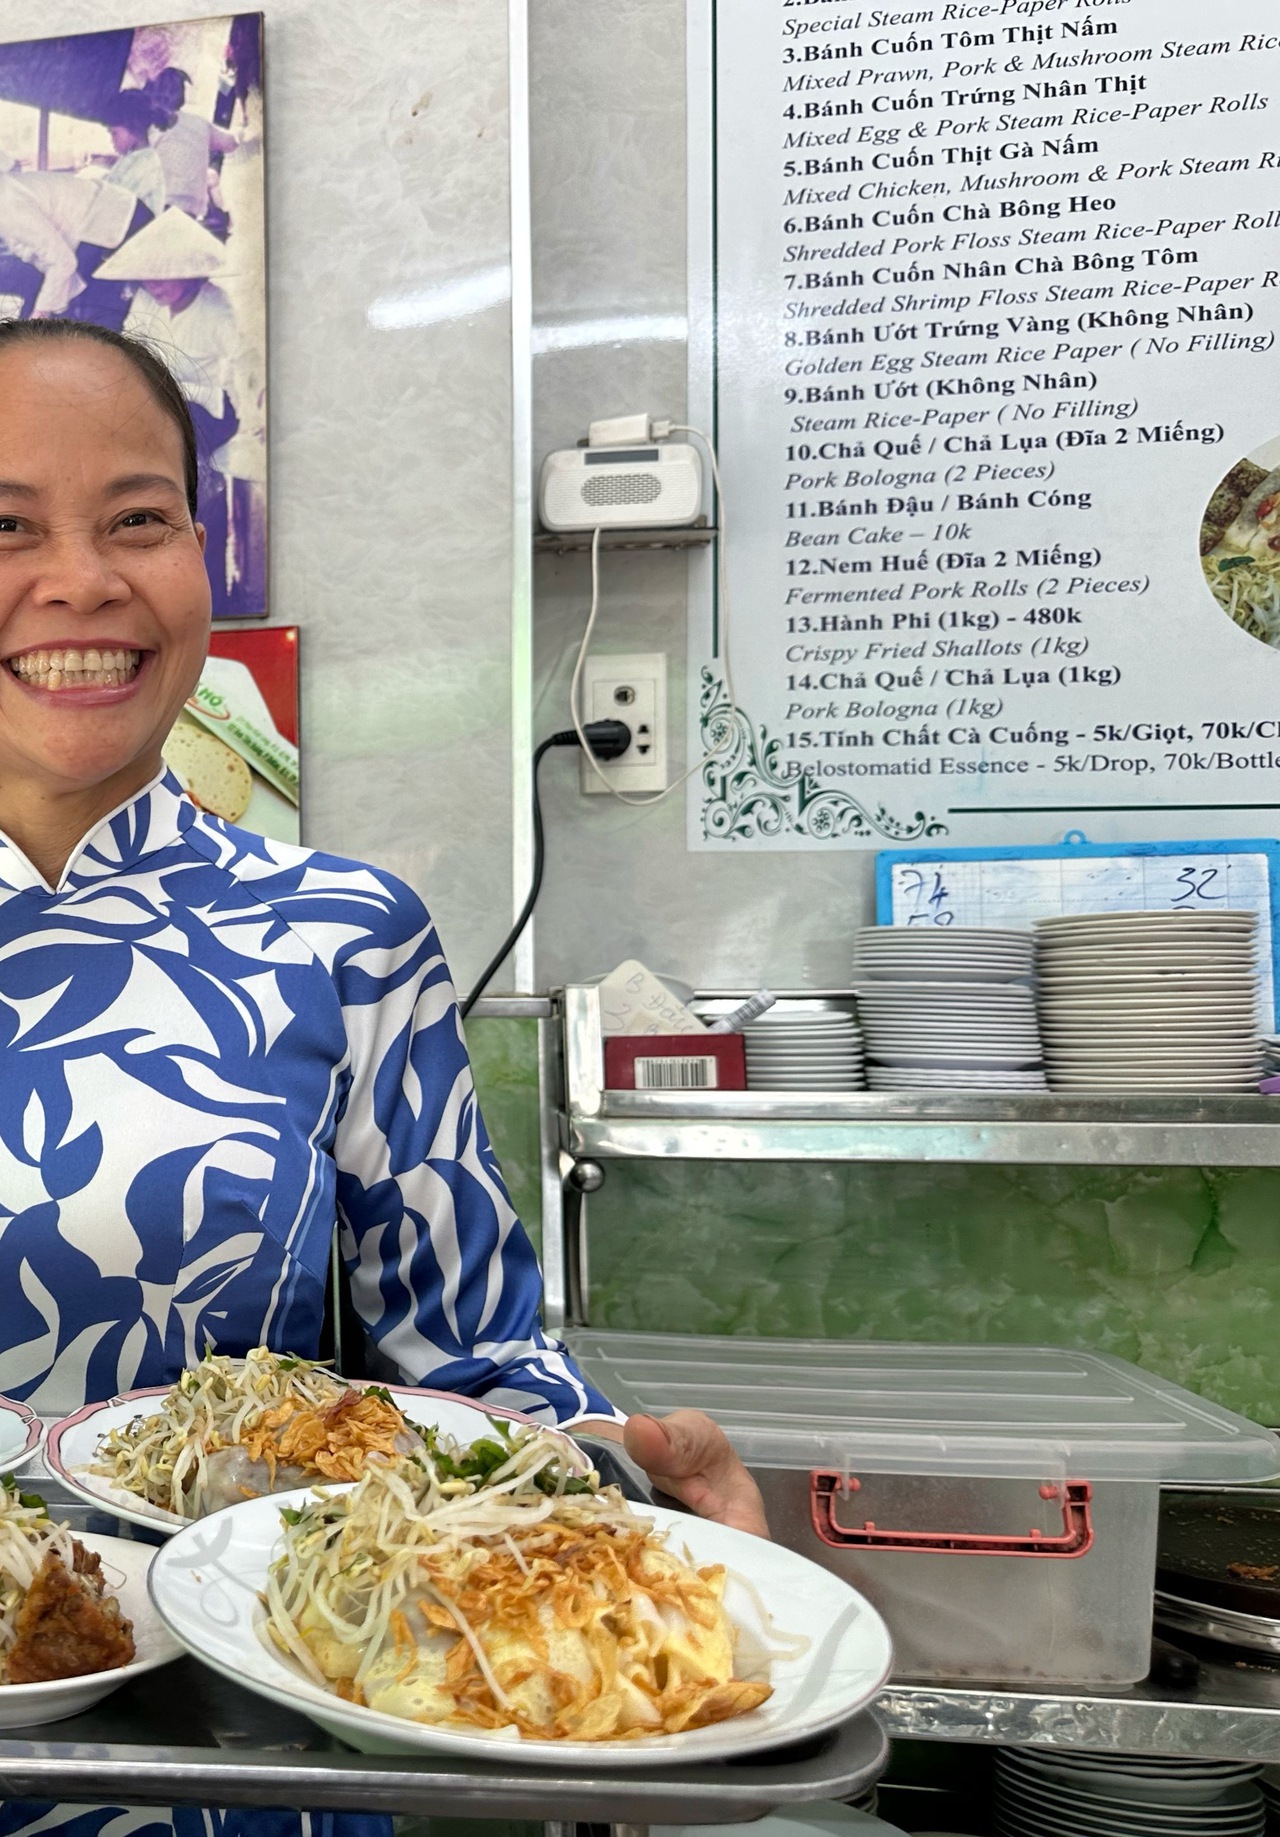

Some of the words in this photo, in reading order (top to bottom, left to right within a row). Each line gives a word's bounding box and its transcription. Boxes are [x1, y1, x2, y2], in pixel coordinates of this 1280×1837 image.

[782, 11, 862, 39] Special
[867, 10, 934, 28] Steam
[940, 0, 1068, 21] Rice-Paper
[782, 41, 863, 64] 3.Bánh
[870, 30, 934, 55] Cuốn
[940, 30, 995, 49] Tôm
[1002, 24, 1054, 45] Thịt
[1060, 14, 1118, 39] Nấm
[782, 69, 851, 92] Mixed
[855, 68, 933, 86] Prawn,
[941, 57, 998, 78] Pork
[1003, 55, 1024, 73] &
[1030, 48, 1152, 70] Mushroom
[1160, 41, 1231, 59] Steam
[1238, 33, 1280, 52] Ric
[782, 98, 864, 120] 4.Bánh
[871, 88, 934, 113] Cuốn
[940, 86, 1016, 106] Trứng
[1022, 79, 1087, 100] Nhân
[1094, 74, 1147, 95] Thịt
[782, 126, 852, 149] Mixed
[856, 125, 901, 146] Egg
[907, 121, 927, 139] &
[934, 115, 990, 136] Pork
[995, 113, 1063, 131] Steam
[1070, 102, 1203, 125] Rice-Paper
[1207, 92, 1269, 114] Rolls
[783, 155, 864, 177] 5.Bánh
[871, 145, 934, 170] Cuốn
[941, 145, 992, 166] Thịt
[999, 141, 1034, 160] Gà
[1041, 132, 1099, 157] Nấm
[782, 183, 852, 206] Mixed
[858, 178, 951, 200] Chicken,
[959, 170, 1079, 192] Mushroom
[1088, 164, 1108, 182] &
[1115, 159, 1174, 180] Pork
[1179, 157, 1249, 175] Steam
[783, 212, 864, 234] 6.Bánh
[871, 202, 935, 227] Cuốn
[942, 202, 991, 222] Chà
[998, 199, 1061, 219] Bông
[1068, 195, 1116, 213] Heo
[782, 238, 886, 262] Shredded
[890, 234, 946, 255] Pork
[950, 231, 1011, 251] Floss
[1017, 228, 1086, 246] Steam
[1093, 218, 1226, 240] Rice-Paper
[783, 269, 864, 290] 7.Bánh
[872, 260, 935, 285] Cuốn
[943, 260, 1007, 280] Nhân
[1014, 255, 1064, 275] Chà
[1072, 252, 1135, 272] Bông
[1141, 247, 1199, 266] Tôm
[783, 295, 886, 319] Shredded
[890, 293, 971, 313] Shrimp
[977, 288, 1038, 307] Floss
[1044, 284, 1114, 302] Steam
[1121, 275, 1255, 297] Rice-Paper
[784, 327, 864, 347] 8.Bánh
[873, 321, 918, 342] Ướt
[924, 319, 1000, 340] Trứng
[1005, 315, 1070, 335] Vàng
[1077, 308, 1169, 333] (Không
[1176, 302, 1254, 323] Nhân)
[784, 355, 863, 376] Golden
[870, 353, 915, 375] Egg
[920, 350, 988, 368] Steam
[995, 346, 1046, 364] Rice
[1052, 342, 1123, 363] Paper
[1145, 336, 1179, 355] No
[1186, 330, 1275, 353] Filling)
[784, 384, 865, 405] 9.Bánh
[874, 379, 919, 399] Ướt
[925, 376, 1016, 400] (Không
[1022, 370, 1097, 391] Nhân)
[790, 415, 856, 433] Steam
[863, 408, 990, 429] Rice-Paper
[1012, 403, 1045, 421] No
[1052, 397, 1138, 420] Filling)
[873, 432, 922, 460] Quế
[1000, 433, 1048, 454] Lụa
[1114, 427, 1128, 445] 2
[1136, 419, 1224, 445] Miếng)
[784, 470, 838, 490] Pork
[843, 468, 936, 489] Bologna
[944, 464, 967, 486] (2
[973, 460, 1055, 482] Pieces)
[787, 498, 878, 519] 11.Bánh
[886, 495, 934, 517] Đậu
[957, 491, 1019, 511] Bánh
[1027, 488, 1092, 510] Cóng
[784, 530, 840, 547] Bean
[847, 525, 904, 545] Cake
[932, 522, 972, 541] 10k
[787, 557, 872, 576] 12.Nem
[881, 548, 929, 572] Huế
[994, 550, 1007, 567] 2
[1015, 542, 1102, 569] Miếng)
[784, 583, 905, 605] Fermented
[909, 580, 965, 600] Pork
[970, 578, 1028, 598] Rolls
[1036, 577, 1059, 599] (2
[1066, 574, 1150, 596] Pieces)
[787, 613, 883, 633] 13.Hành
[892, 611, 931, 629] Phi
[938, 610, 1000, 632] (1kg)
[1023, 606, 1082, 625] 480k
[785, 645, 858, 665] Crispy
[864, 640, 927, 660] Fried
[932, 638, 1023, 658] Shallots
[1030, 636, 1089, 658] (1kg)
[874, 665, 924, 692] Quế
[1003, 667, 1050, 688] Lụa
[1058, 665, 1121, 687] (1kg)
[785, 701, 838, 720] Pork
[845, 699, 938, 721] Bologna
[946, 697, 1004, 719] (1kg)
[882, 723, 940, 746] Chất
[947, 726, 981, 745] Cà
[988, 720, 1069, 747] Cuống
[1093, 723, 1194, 745] 5k/Giọt,
[785, 757, 933, 777] Belostomatid
[939, 757, 1029, 774] Essence
[1053, 754, 1156, 776] 5k/Drop,
[1171, 867, 1227, 900] 32
